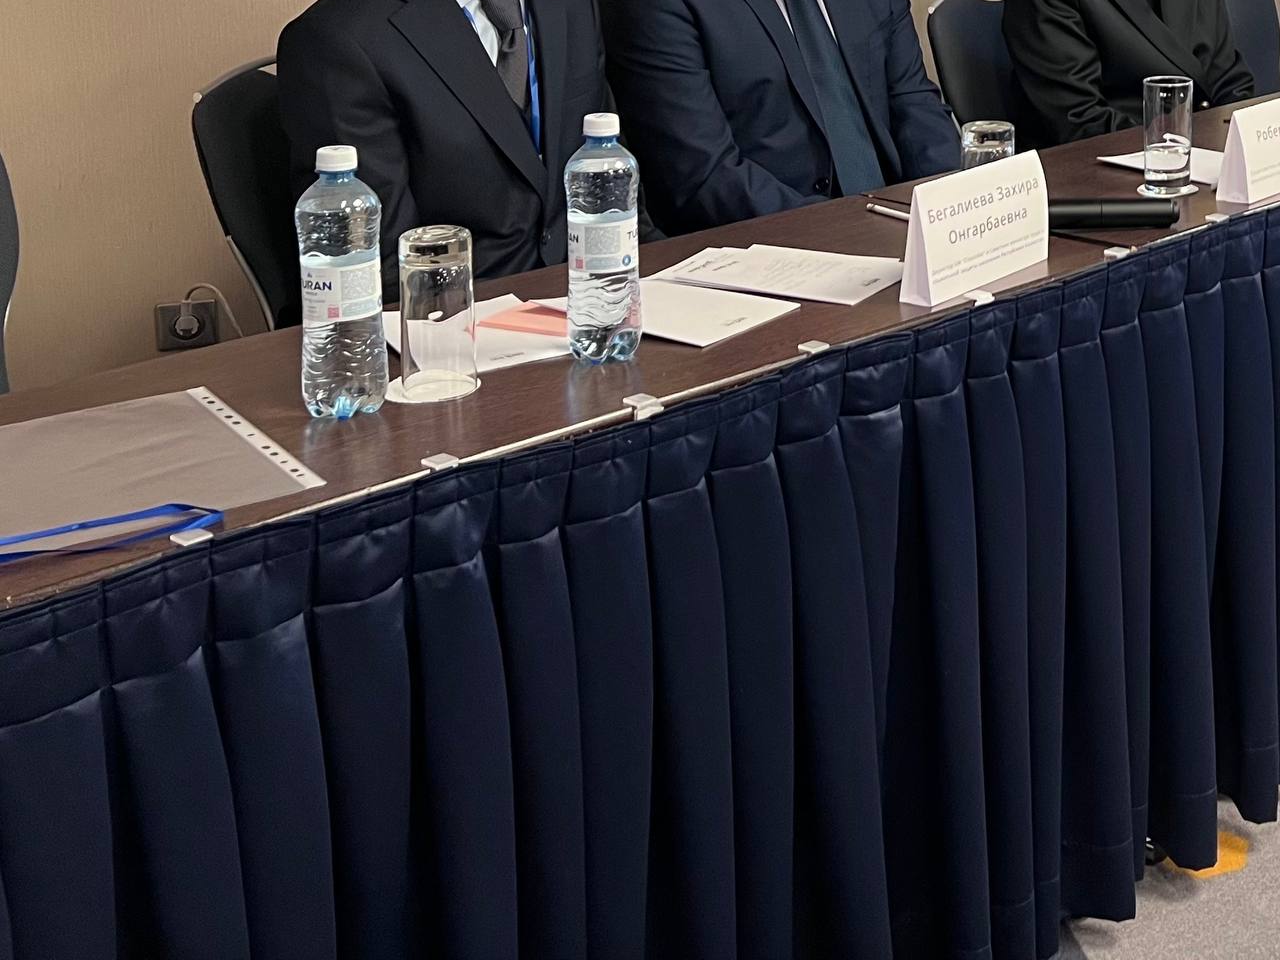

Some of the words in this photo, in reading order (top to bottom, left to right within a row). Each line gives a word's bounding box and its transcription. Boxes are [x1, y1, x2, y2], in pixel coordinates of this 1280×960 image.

[927, 192, 994, 224] Бегалиева
[997, 177, 1040, 201] Захира
[948, 207, 1028, 245] Онгарбаевна
[303, 280, 332, 291] URAN
